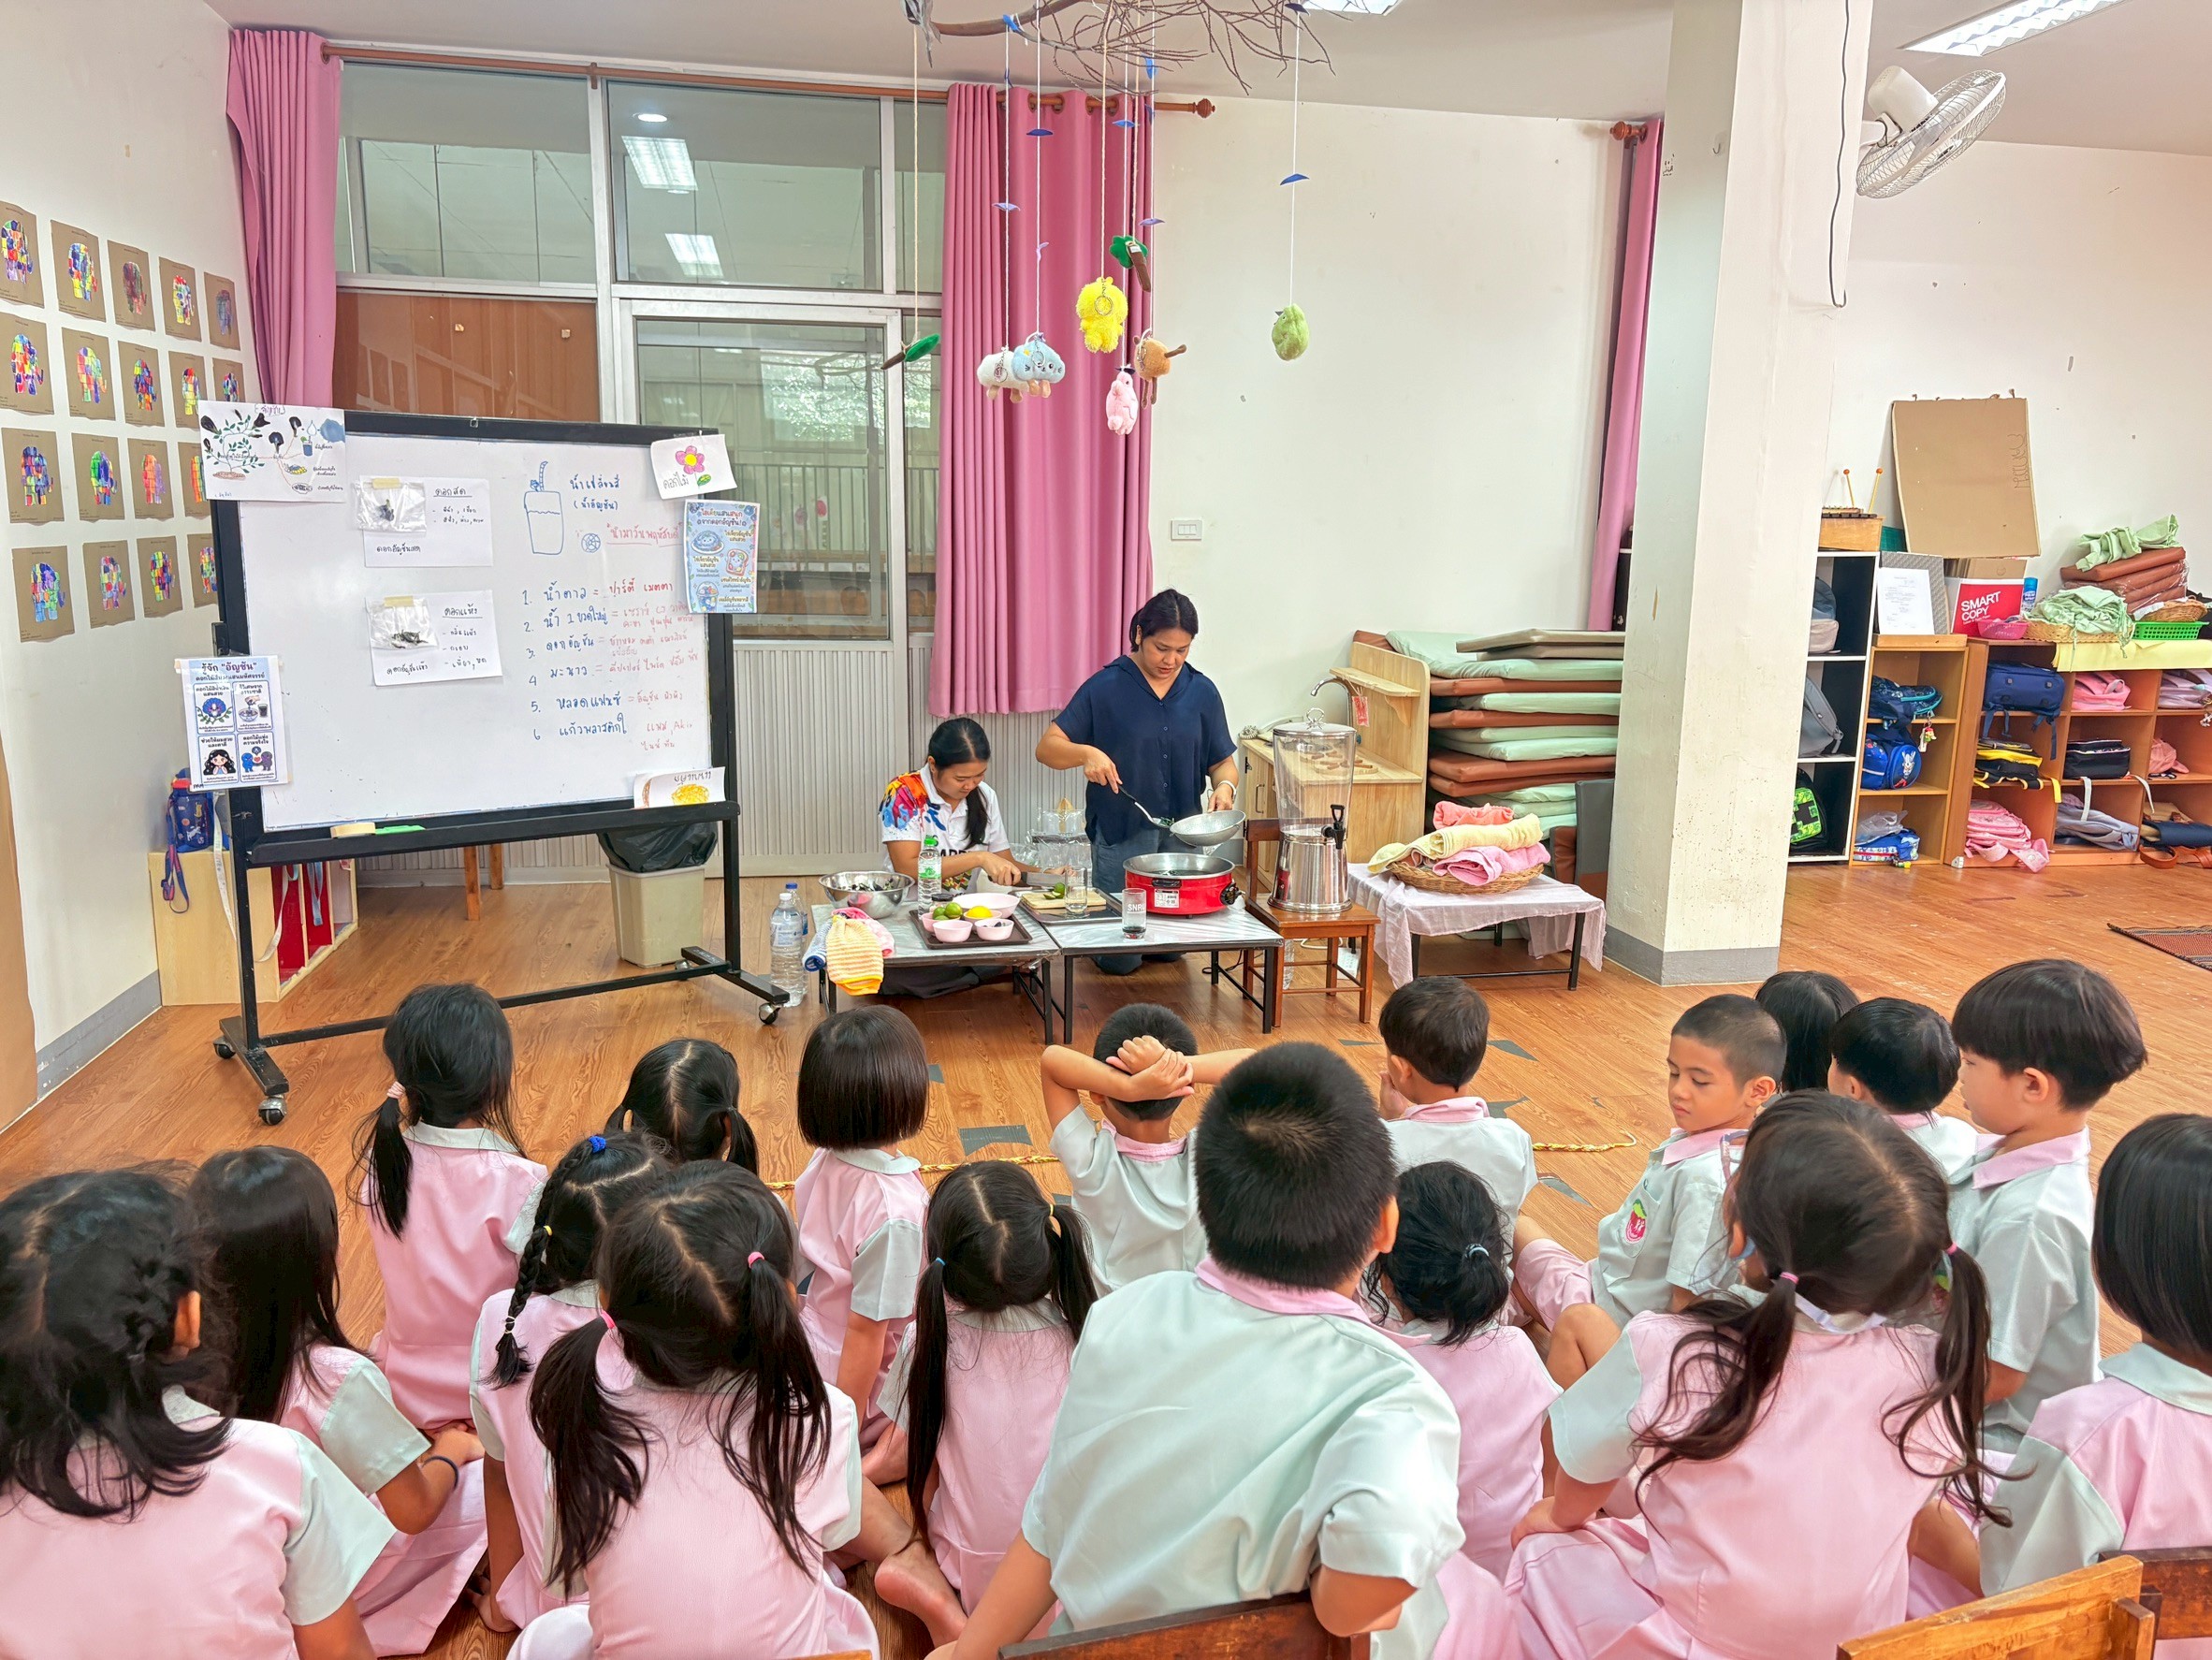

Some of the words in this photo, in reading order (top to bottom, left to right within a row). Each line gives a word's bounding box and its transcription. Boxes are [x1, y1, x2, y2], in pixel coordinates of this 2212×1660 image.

[663, 472, 689, 489] ดอกไม้
[435, 487, 467, 496] ดอกสด
[1961, 591, 2001, 611] SMART
[1961, 605, 1989, 621] COPY
